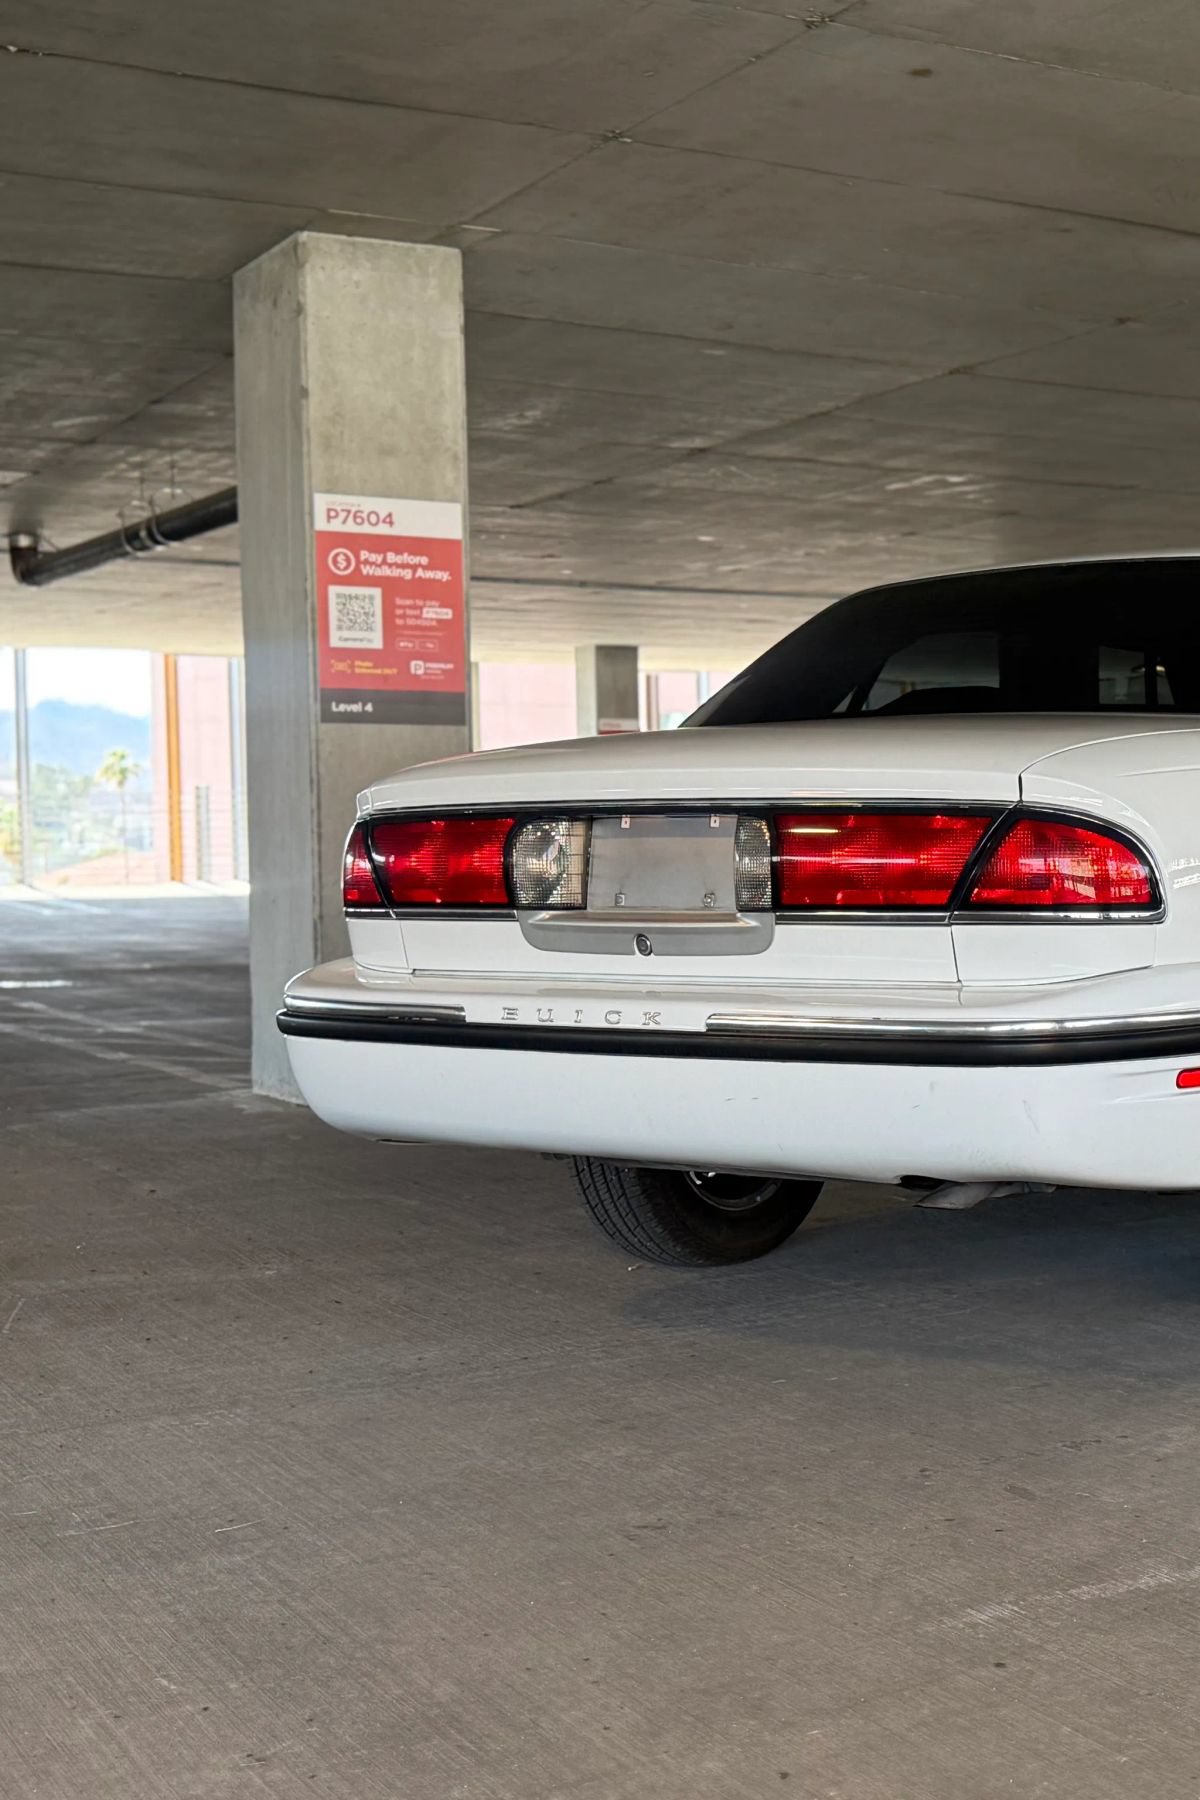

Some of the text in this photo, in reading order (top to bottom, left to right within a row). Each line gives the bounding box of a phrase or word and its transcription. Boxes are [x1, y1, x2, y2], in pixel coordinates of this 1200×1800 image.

[326, 507, 395, 528] P7604
[360, 550, 429, 566] Pay Before
[360, 564, 452, 582] Walking Away.
[332, 701, 374, 713] Level 4
[501, 1007, 661, 1026] BUICK
